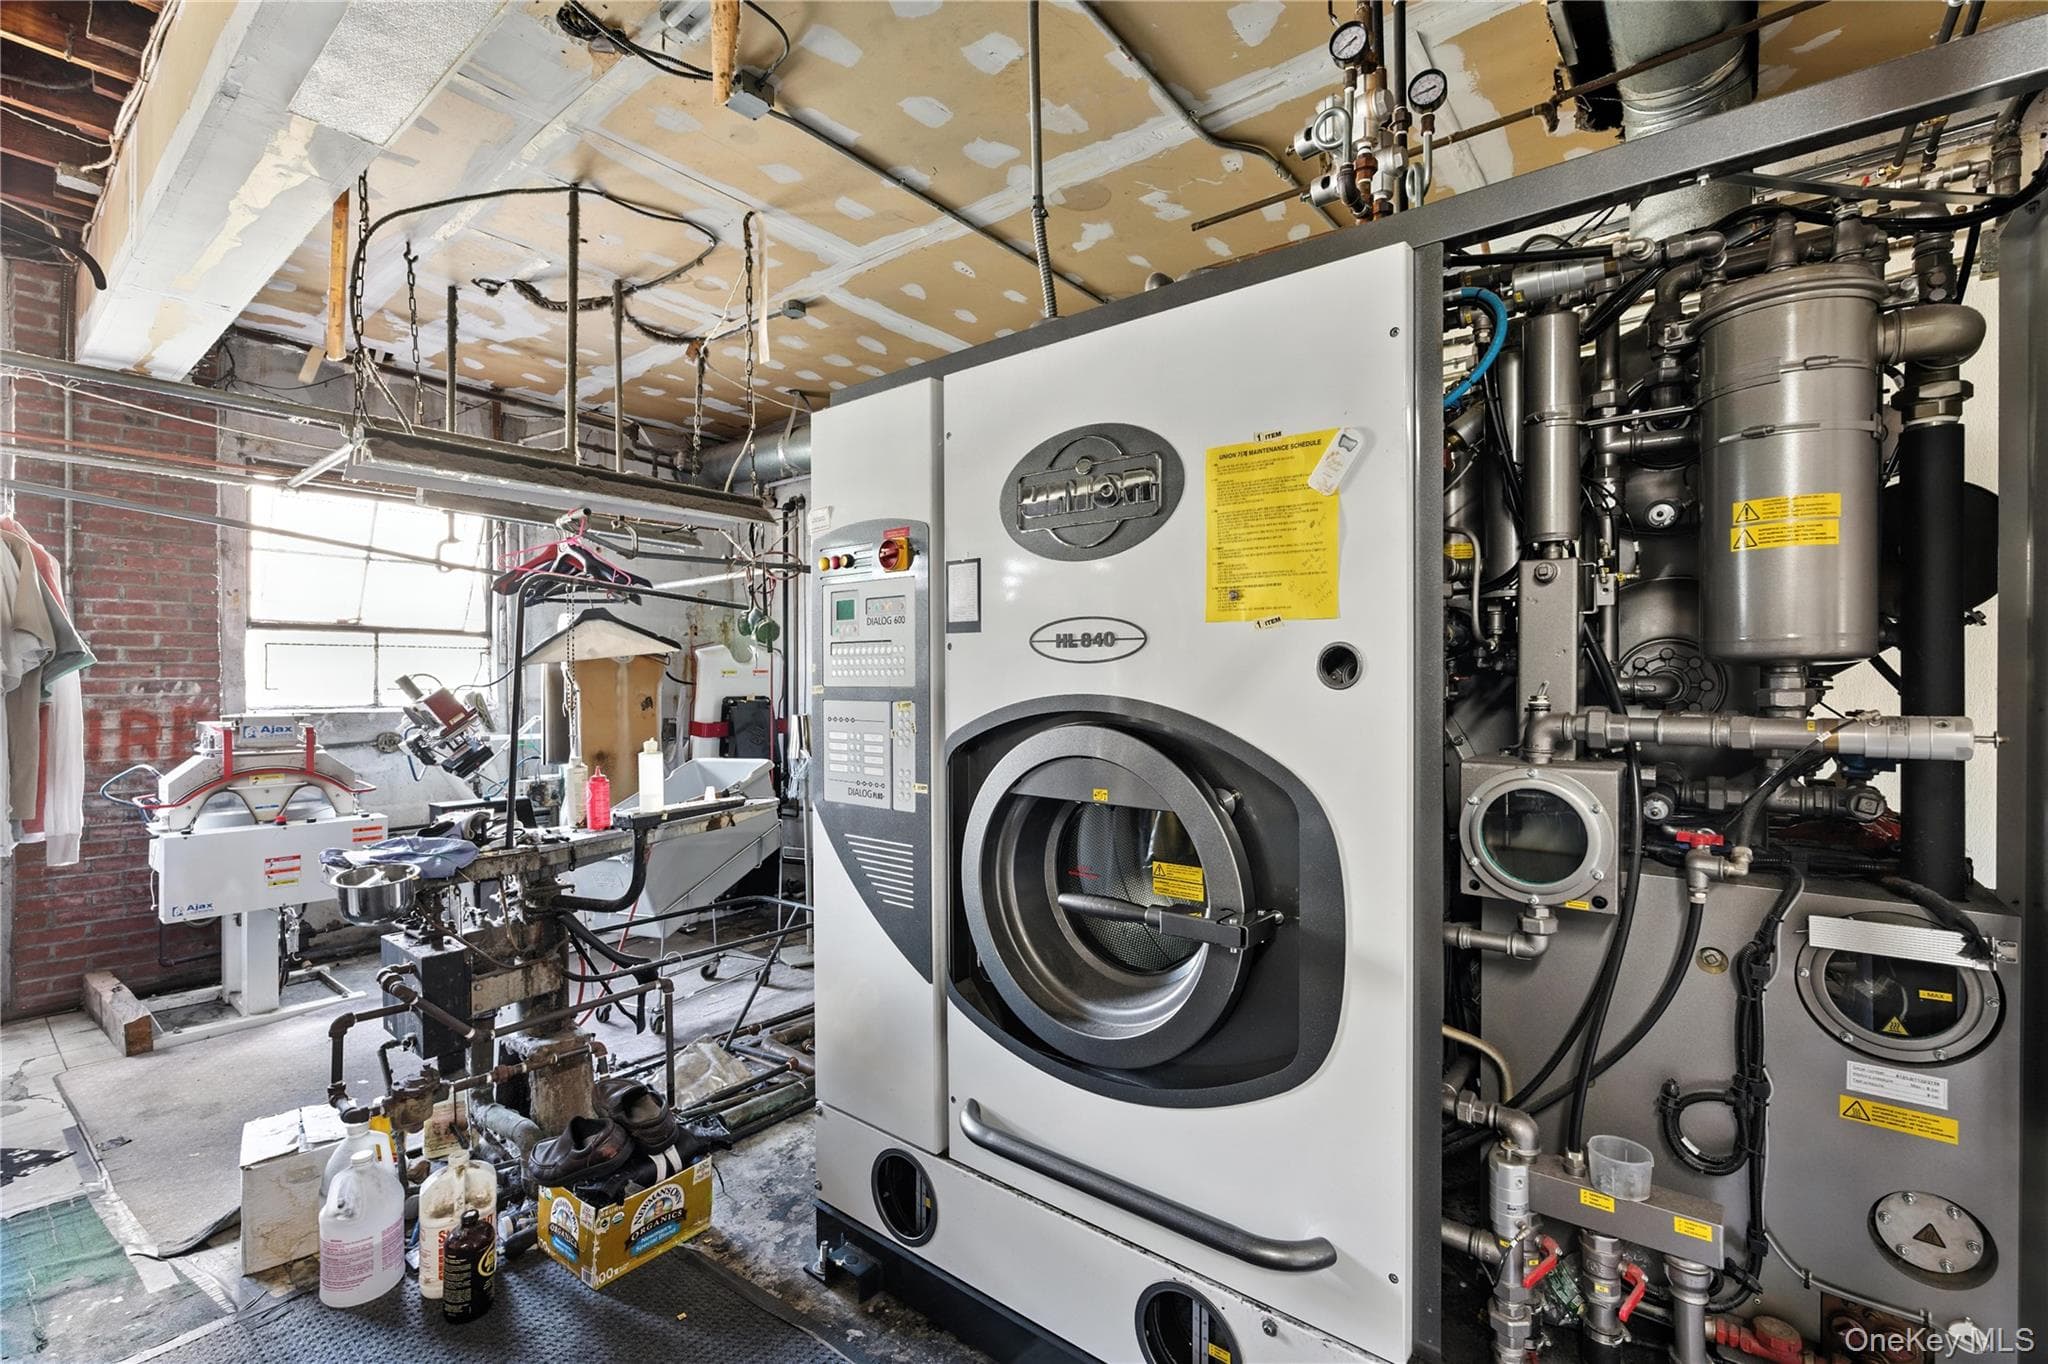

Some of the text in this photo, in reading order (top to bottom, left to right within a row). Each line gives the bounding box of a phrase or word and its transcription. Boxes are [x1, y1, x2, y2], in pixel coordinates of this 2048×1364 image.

[1248, 444, 1289, 456] MAINTENANCE
[1290, 439, 1322, 450] SCHEDULE
[866, 615, 906, 625] DIALOG 600
[1055, 631, 1116, 648] HL 840
[260, 725, 293, 734] Ajax
[848, 787, 872, 798] DIALOG
[186, 902, 214, 911] Ajax
[631, 1209, 684, 1241] ORGANICS
